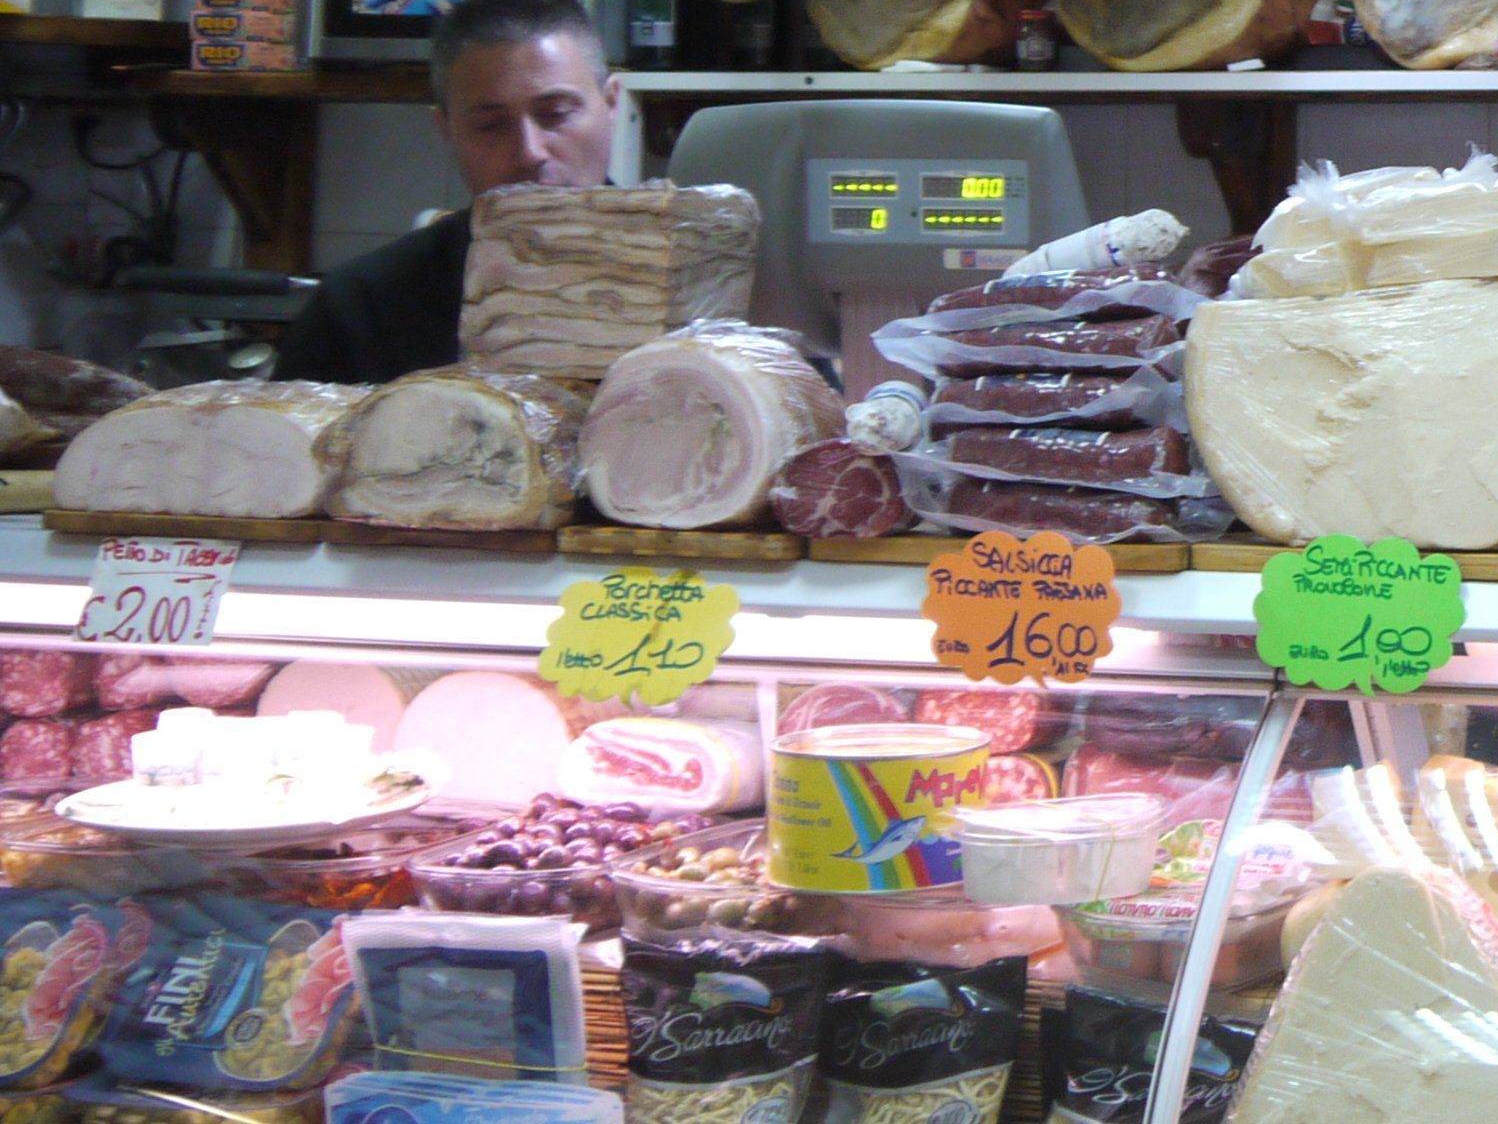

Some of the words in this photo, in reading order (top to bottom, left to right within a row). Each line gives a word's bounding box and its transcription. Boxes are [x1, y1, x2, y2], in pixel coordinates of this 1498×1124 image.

[197, 16, 239, 30] RIO
[200, 46, 241, 60] RIO
[905, 768, 985, 808] Mare
